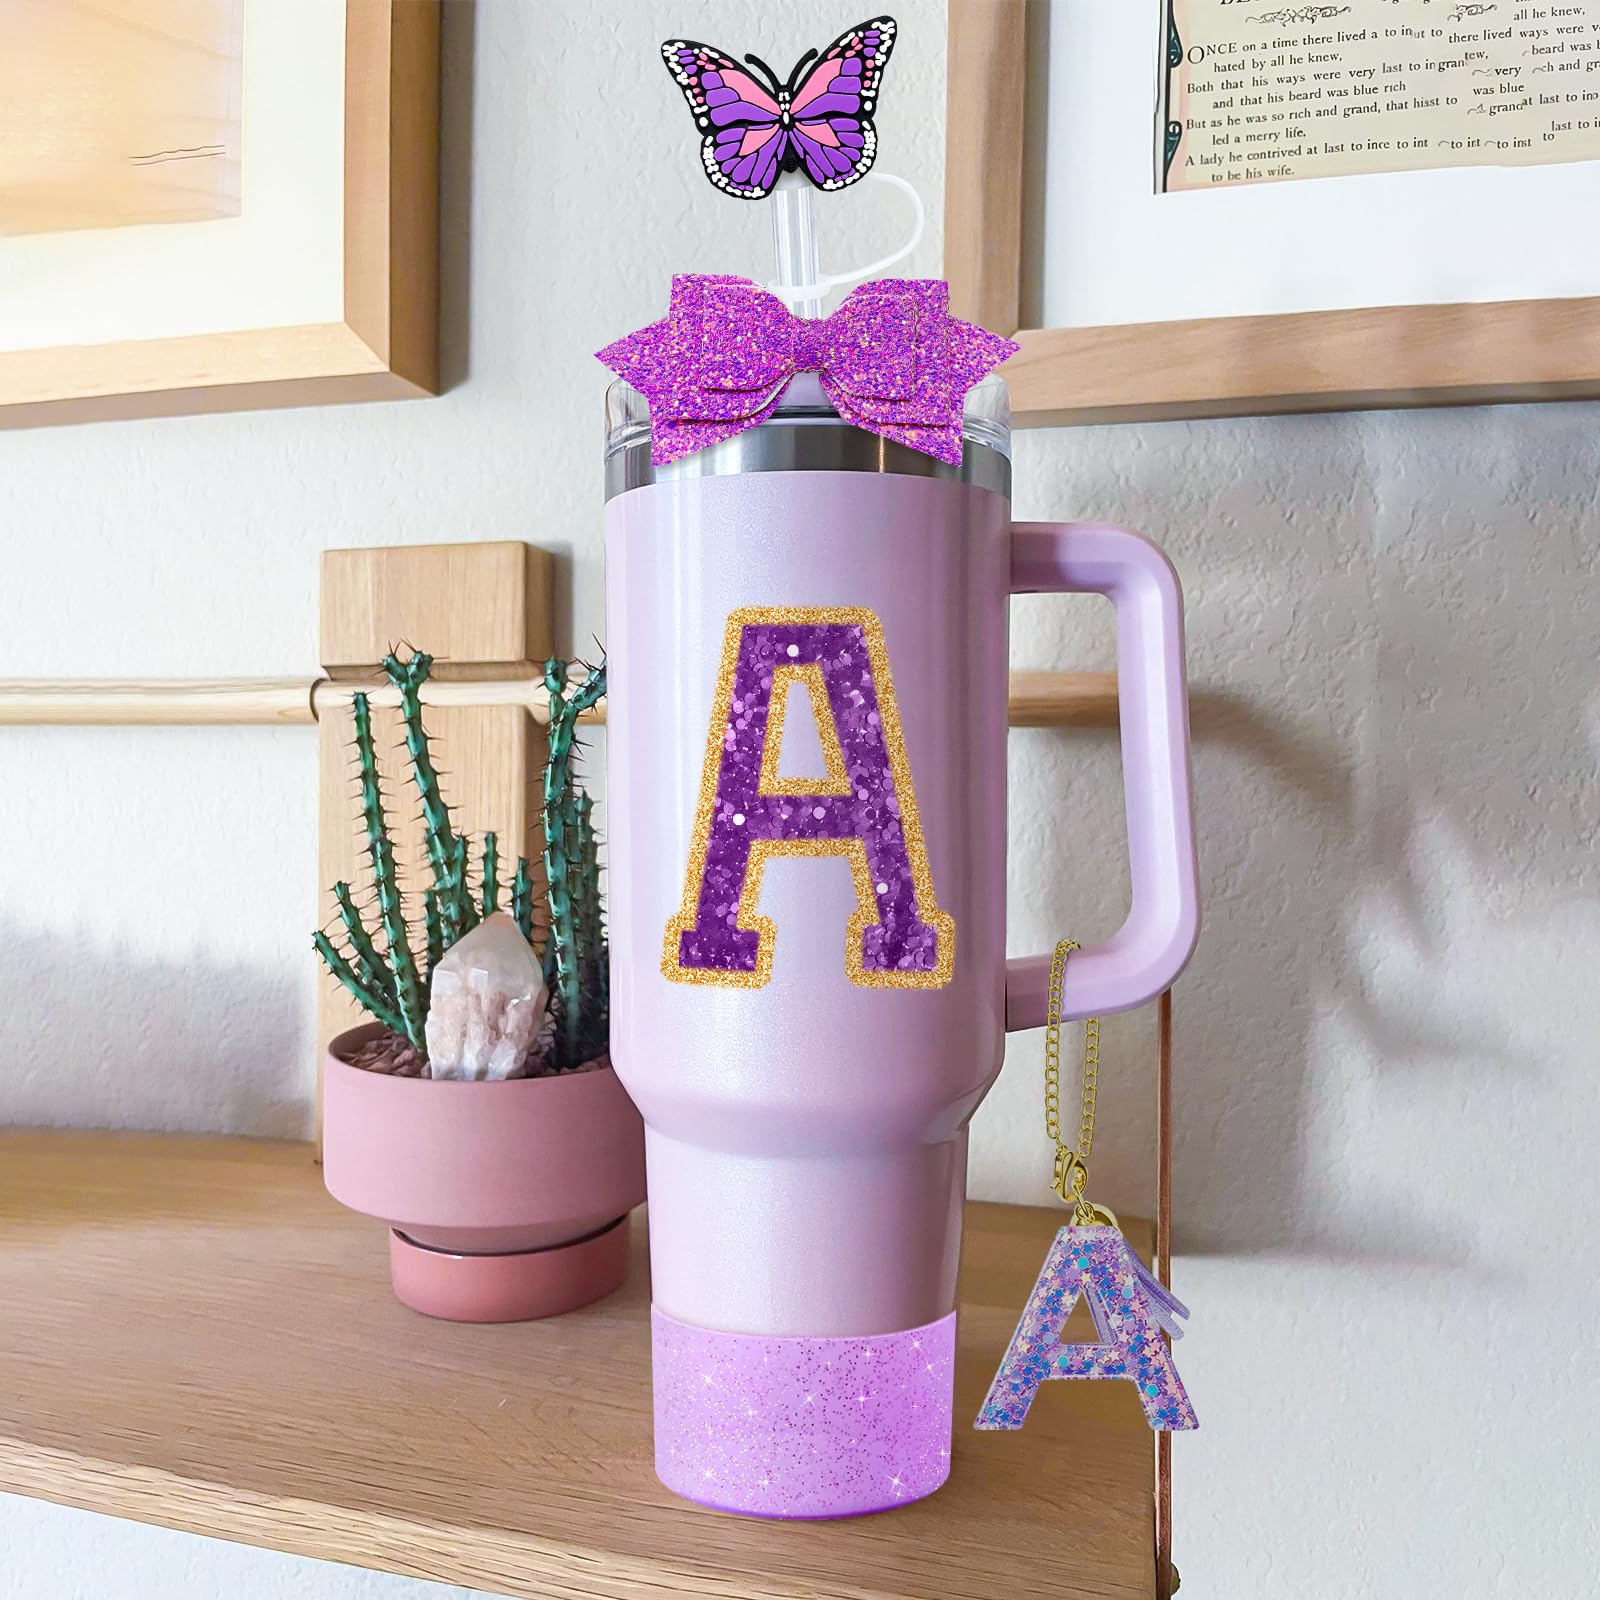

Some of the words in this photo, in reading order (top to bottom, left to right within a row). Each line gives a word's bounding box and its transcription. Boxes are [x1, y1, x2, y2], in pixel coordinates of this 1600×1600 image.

[1513, 9, 1528, 21] all
[1532, 8, 1547, 19] he
[1551, 6, 1586, 17] knew,
[1449, 32, 1479, 43] there
[1483, 27, 1512, 41] lived
[1520, 29, 1549, 39] ways
[1556, 25, 1584, 35] were
[1187, 42, 1237, 64] ONCE
[1242, 43, 1256, 52] on
[1261, 42, 1268, 50] a
[1272, 38, 1298, 49] time
[1303, 34, 1333, 45] there
[1337, 29, 1366, 42] lived
[1371, 31, 1378, 39] a
[1385, 29, 1397, 37] to
[1431, 28, 1443, 37] to
[1531, 42, 1564, 55] beard
[1570, 43, 1592, 52] was
[1214, 60, 1245, 73] hated
[1252, 58, 1266, 71] by
[1270, 55, 1284, 67] all
[1290, 54, 1304, 65] he
[1308, 52, 1342, 63] knew,
[1495, 66, 1522, 78] very
[1558, 58, 1580, 71] and
[1187, 81, 1214, 94] Both
[1221, 79, 1244, 90] that
[1252, 76, 1269, 87] his
[1277, 74, 1306, 86] ways
[1313, 71, 1341, 81] were
[1349, 68, 1376, 80] very
[1382, 62, 1403, 74] last
[1409, 62, 1421, 72] to
[1212, 97, 1233, 109] and
[1240, 95, 1262, 107] that
[1267, 93, 1284, 104] his
[1289, 87, 1321, 102] beard
[1327, 89, 1349, 98] was
[1353, 84, 1379, 96] blue
[1472, 86, 1495, 95] was
[1500, 82, 1525, 94] blue
[1539, 93, 1560, 105] last
[1566, 93, 1578, 102] to
[1186, 119, 1206, 130] But
[1210, 119, 1222, 128] as
[1227, 115, 1241, 126] he
[1245, 114, 1267, 124] was
[1271, 113, 1284, 122] so
[1289, 107, 1311, 120] rich
[1315, 105, 1337, 117] and
[1343, 101, 1381, 119] grand,
[1386, 100, 1408, 112] that
[1446, 96, 1458, 105] to
[1551, 120, 1571, 131] last
[1578, 120, 1590, 129] to
[1212, 133, 1229, 146] led
[1234, 135, 1241, 143] a
[1246, 131, 1280, 142] merry
[1285, 126, 1306, 138] life.
[1185, 155, 1195, 167] A
[1200, 153, 1224, 167] lady
[1229, 152, 1243, 162] he
[1247, 145, 1301, 161] contrived
[1306, 146, 1318, 155] at
[1324, 142, 1345, 154] last
[1351, 142, 1363, 151] to
[1397, 140, 1409, 149] to
[1451, 140, 1463, 149] to
[1497, 140, 1509, 149] to
[1543, 133, 1555, 141] to
[1211, 173, 1223, 182] to
[1228, 170, 1241, 181] be
[1246, 167, 1262, 179] his
[1267, 165, 1295, 177] wife.
[661, 606, 956, 990] A
[973, 1226, 1200, 1431] A
